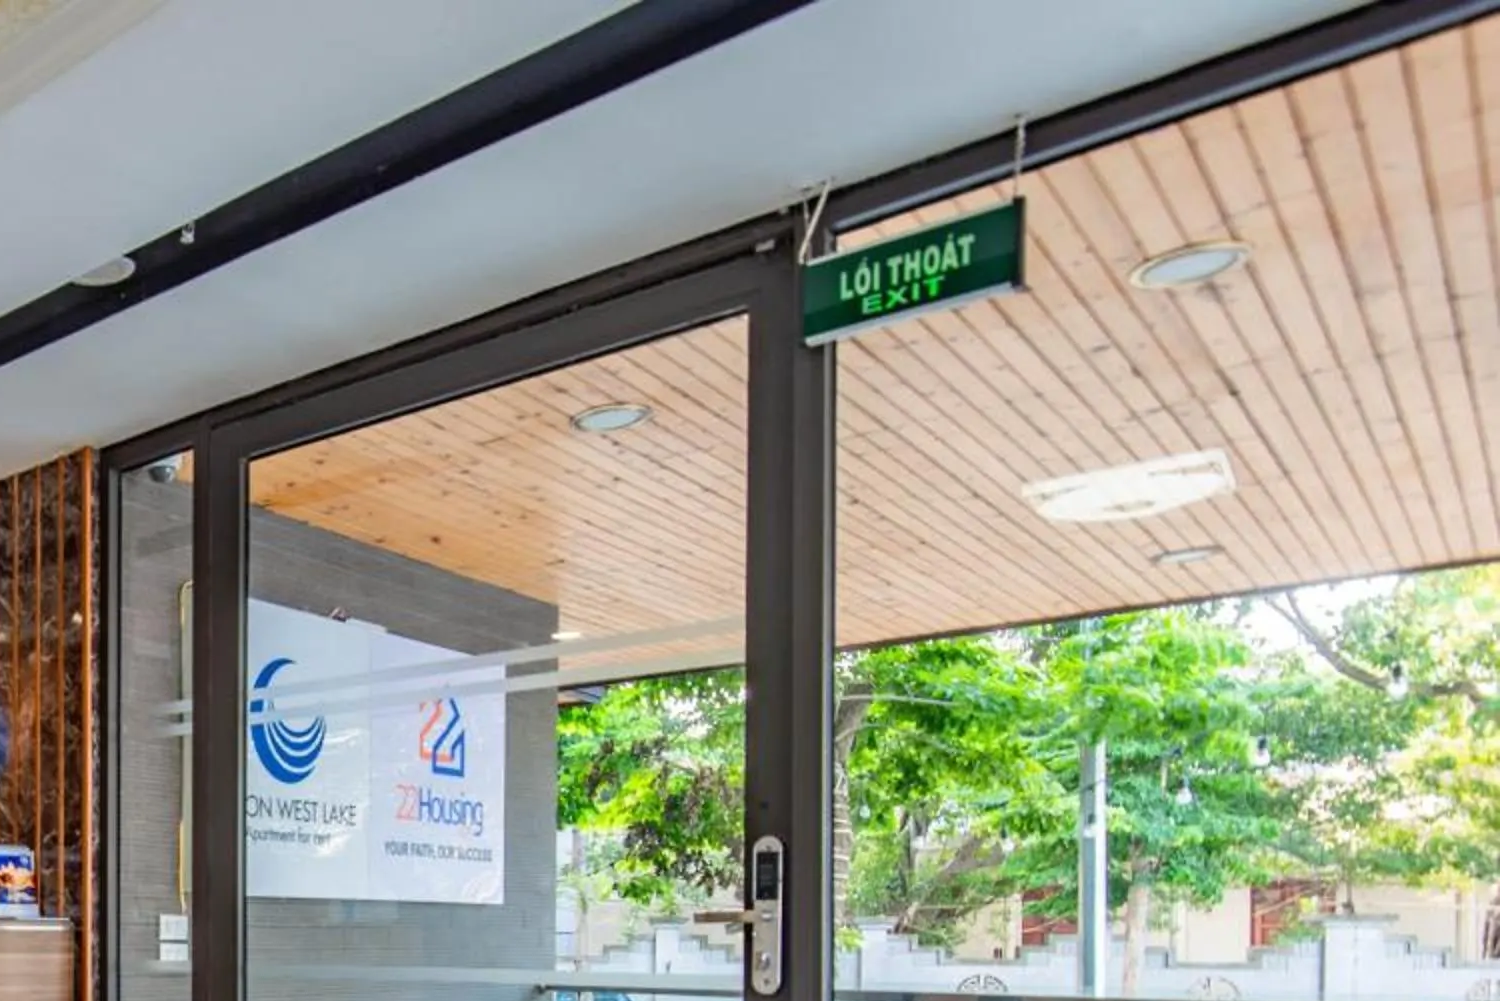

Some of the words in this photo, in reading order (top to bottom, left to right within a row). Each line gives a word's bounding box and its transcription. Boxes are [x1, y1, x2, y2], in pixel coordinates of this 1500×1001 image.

[886, 232, 976, 287] THOÁT
[862, 275, 946, 315] EXIT
[276, 798, 318, 823] WEST
[323, 802, 357, 827] LAKE
